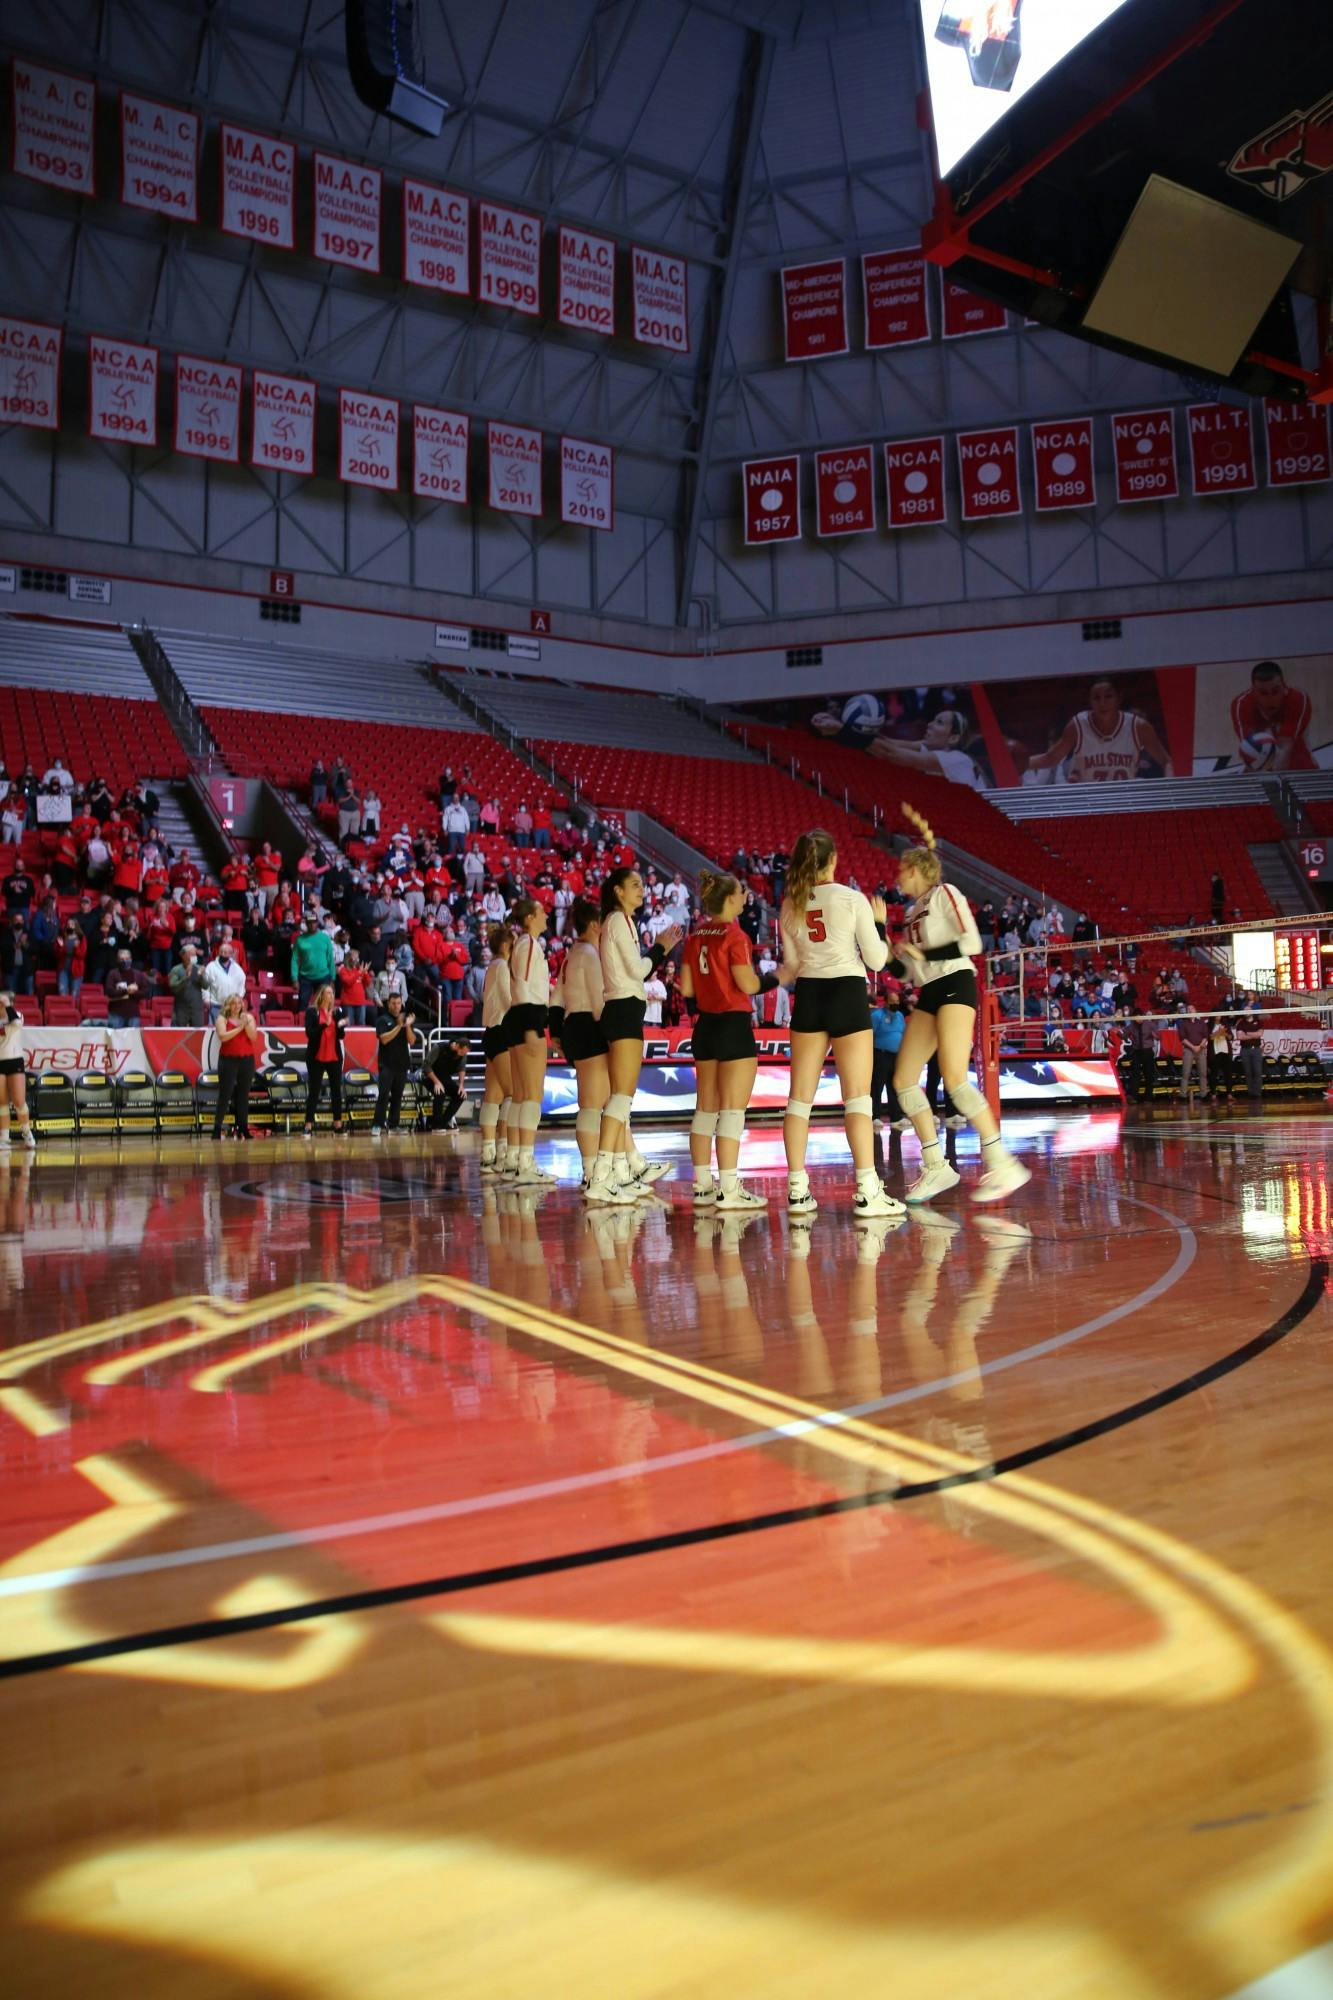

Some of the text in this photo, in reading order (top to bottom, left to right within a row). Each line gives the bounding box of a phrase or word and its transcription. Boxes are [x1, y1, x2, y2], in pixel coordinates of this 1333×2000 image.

[20, 104, 88, 133] VOLLEYBALL
[17, 122, 90, 152] CHAMPIONS
[128, 136, 192, 162] VOLLEYBALL
[226, 135, 291, 175] M.A.C.
[25, 149, 83, 180] 1993
[126, 153, 194, 179] CHAMPIONS
[226, 164, 290, 193] VOLLEYBALL
[317, 162, 379, 200] M.A.C.
[133, 178, 187, 208] 1994
[228, 179, 289, 206] CHAMPIONS
[317, 192, 378, 218] VOLLEYBALL
[408, 190, 466, 226] M.A.C.
[237, 209, 279, 237] 1996
[319, 206, 376, 233] CHAMPIONS
[408, 218, 466, 243] VOLLEYBALL
[482, 211, 538, 247] M.A.C.
[321, 231, 374, 261] 1997
[410, 231, 464, 256] CHAMPIONS
[483, 238, 537, 264] VOLLEYBALL
[561, 235, 613, 270] M.A.C.
[419, 259, 456, 285] 1998
[484, 252, 535, 276] CHAMPIONS
[562, 262, 613, 286] VOLLEYBALL
[635, 255, 684, 288] M.A.C.
[867, 259, 923, 277] MID-AMERICAN
[483, 273, 537, 305] 1999
[563, 276, 612, 298] CHAMPIONS
[635, 280, 684, 302] VOLLEYBALL
[786, 272, 842, 290] MID-AMERICAN
[869, 275, 922, 292] CONFERENCE
[637, 293, 682, 315] CHAMPIONS
[788, 288, 840, 305] CONFERENCE
[873, 291, 919, 308] CHAMPIONS
[562, 298, 612, 326] 2002
[792, 305, 838, 321] CHAMPIONS
[638, 317, 683, 343] 2010
[92, 347, 155, 375] NCAA
[96, 366, 151, 385] VOLLEYBALL
[179, 365, 239, 391] NCAA
[179, 384, 237, 402] VOLLEYBALL
[255, 381, 313, 407] NCAA
[0, 396, 49, 417] 1993
[256, 399, 313, 418] VOLLEYBALL
[342, 399, 396, 424] NCAA
[99, 411, 148, 434] 1994
[343, 417, 396, 435] VOLLEYBALL
[415, 414, 467, 439] NCAA
[1115, 420, 1171, 440] NCAA
[185, 428, 230, 451] 1995
[416, 432, 466, 449] VOLLEYBALL
[490, 430, 540, 453] NCAA
[961, 440, 1015, 460] NCAA
[1035, 431, 1091, 449] NCAA
[261, 442, 305, 463] 1999
[490, 446, 540, 464] VOLLEYBALL
[563, 446, 610, 469] NCAA
[888, 450, 941, 468] NCAA
[348, 458, 390, 480] 2000
[564, 462, 609, 479] VOLLEYBALL
[820, 459, 868, 476] NCAA
[1202, 464, 1248, 483] 1991
[1274, 454, 1326, 475] 1992
[419, 472, 461, 493] 2002
[750, 468, 793, 487] NAIA
[1046, 480, 1086, 497] 1989
[1127, 473, 1168, 491] 1990
[499, 487, 533, 506] 2011
[899, 498, 936, 515] 1981
[971, 489, 1012, 507] 1986
[568, 502, 606, 521] 2019
[829, 510, 865, 526] 1964
[754, 515, 791, 533] 1957
[275, 578, 288, 594] B
[535, 616, 546, 630] A
[223, 790, 234, 812] 1
[1301, 847, 1325, 865] 16
[806, 910, 827, 942] 5
[699, 946, 710, 975] 6
